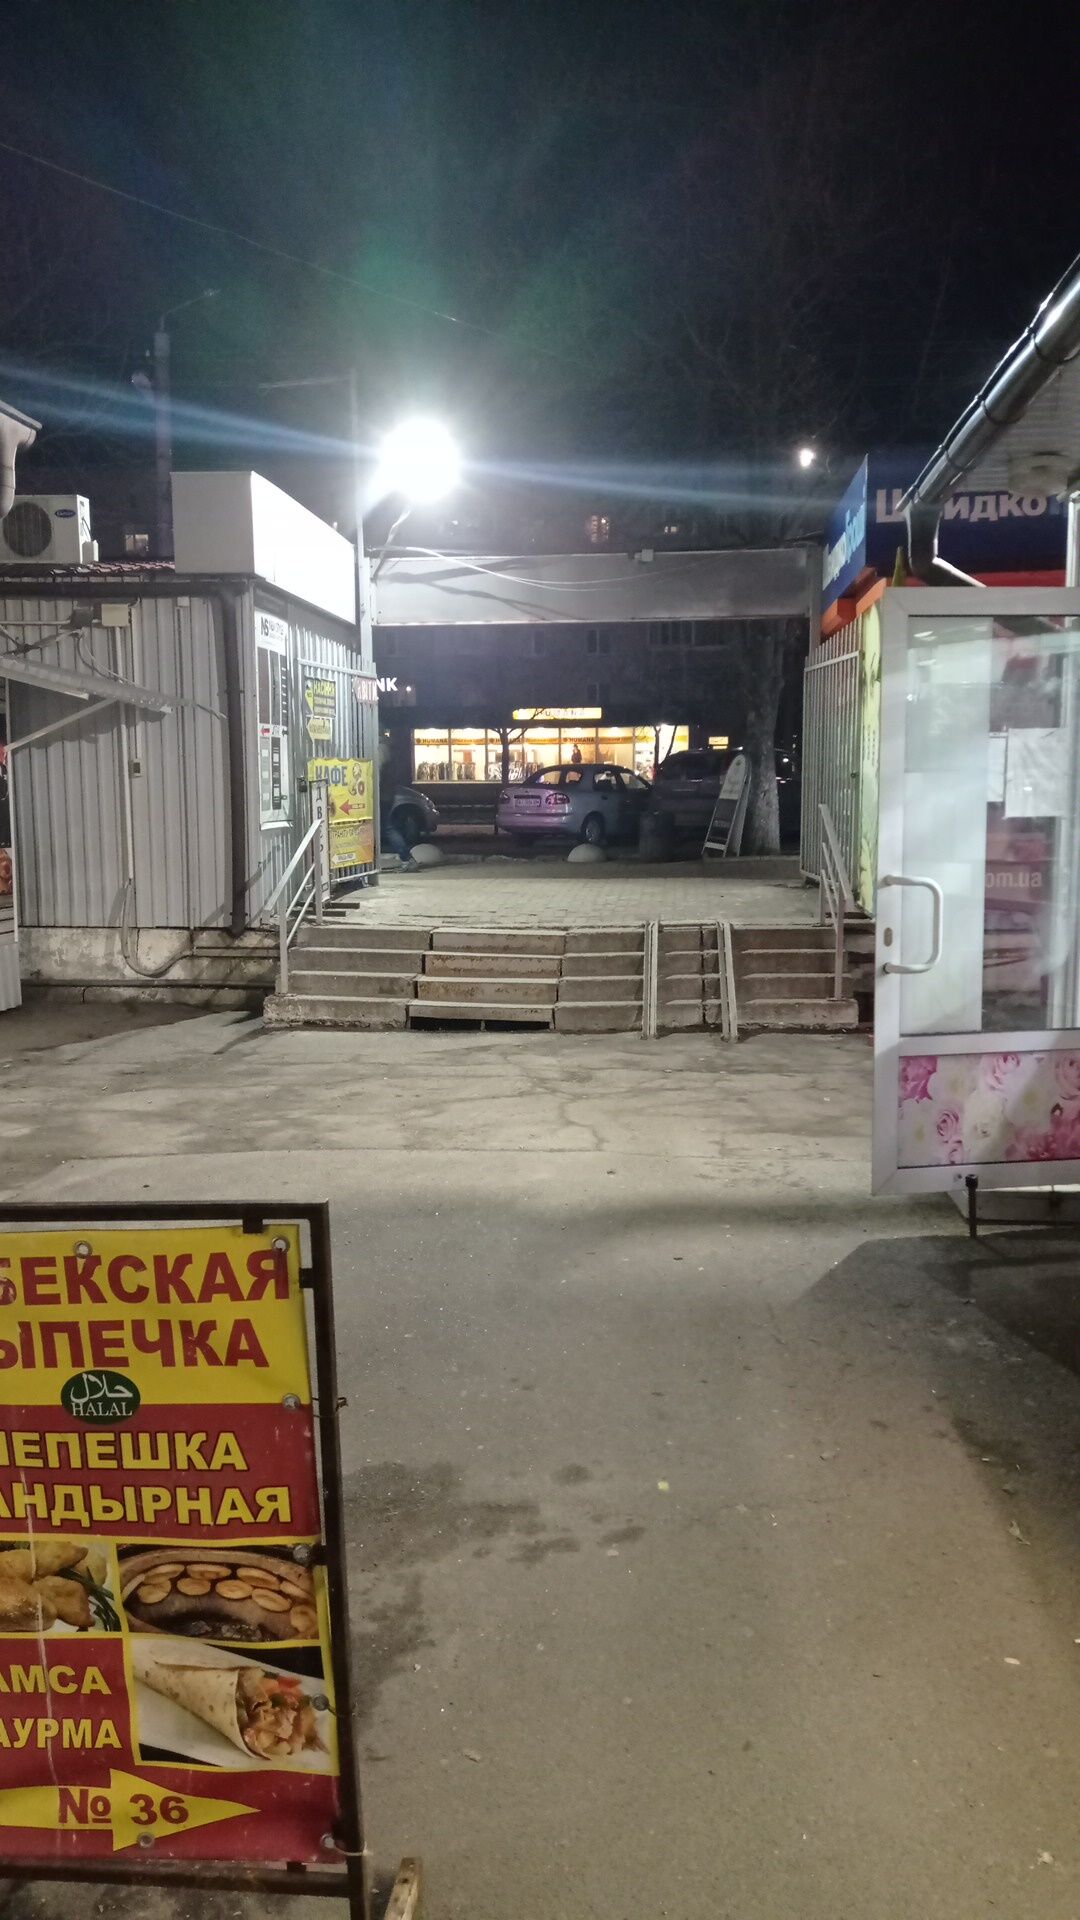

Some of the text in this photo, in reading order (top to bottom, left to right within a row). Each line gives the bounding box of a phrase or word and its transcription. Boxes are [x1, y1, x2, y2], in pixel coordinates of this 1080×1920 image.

[315, 765, 348, 787] КАФЕ
[0, 1318, 270, 1369] ЫПЕЧКА
[70, 1373, 133, 1403] حلال
[71, 1401, 132, 1416] HALAL
[130, 1793, 189, 1825] 36
